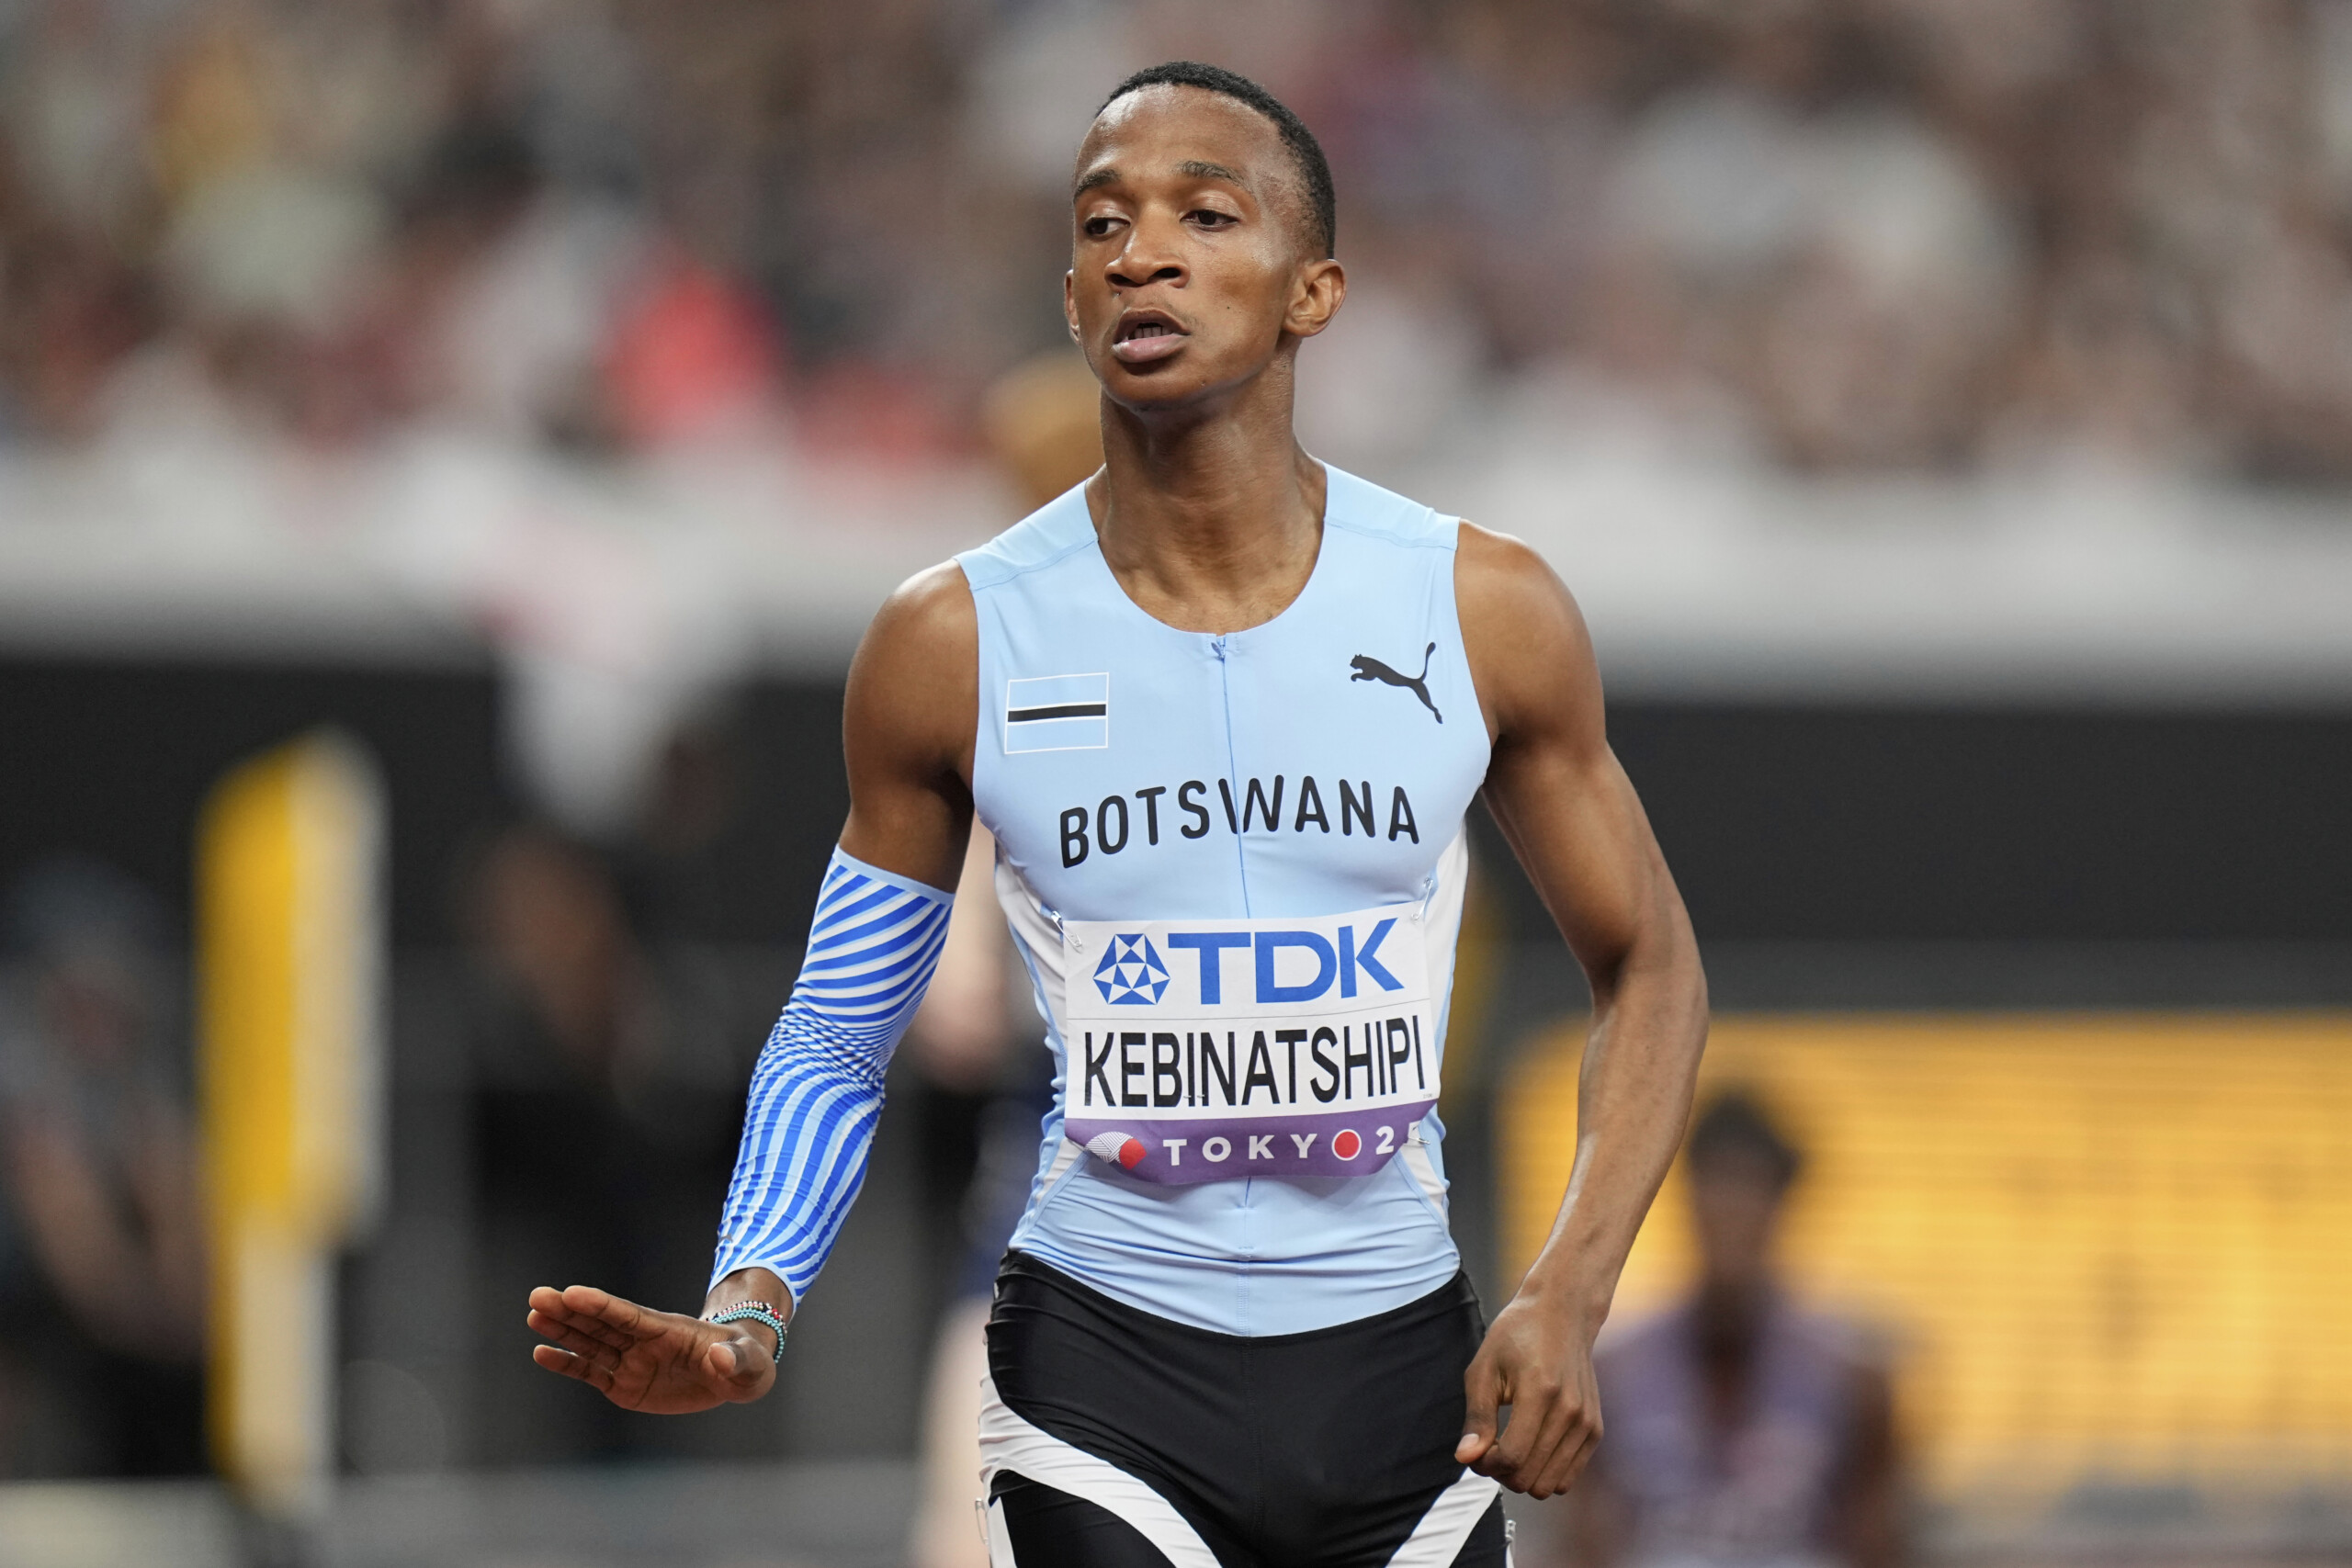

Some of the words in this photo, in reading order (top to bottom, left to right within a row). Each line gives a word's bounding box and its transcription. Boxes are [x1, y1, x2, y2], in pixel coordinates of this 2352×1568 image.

[1059, 774, 1419, 869] BOTSWANA
[1168, 917, 1405, 1005] TDK
[1084, 1014, 1426, 1108] KEBINATSHIPI
[1162, 1128, 1363, 1167] TOKYO
